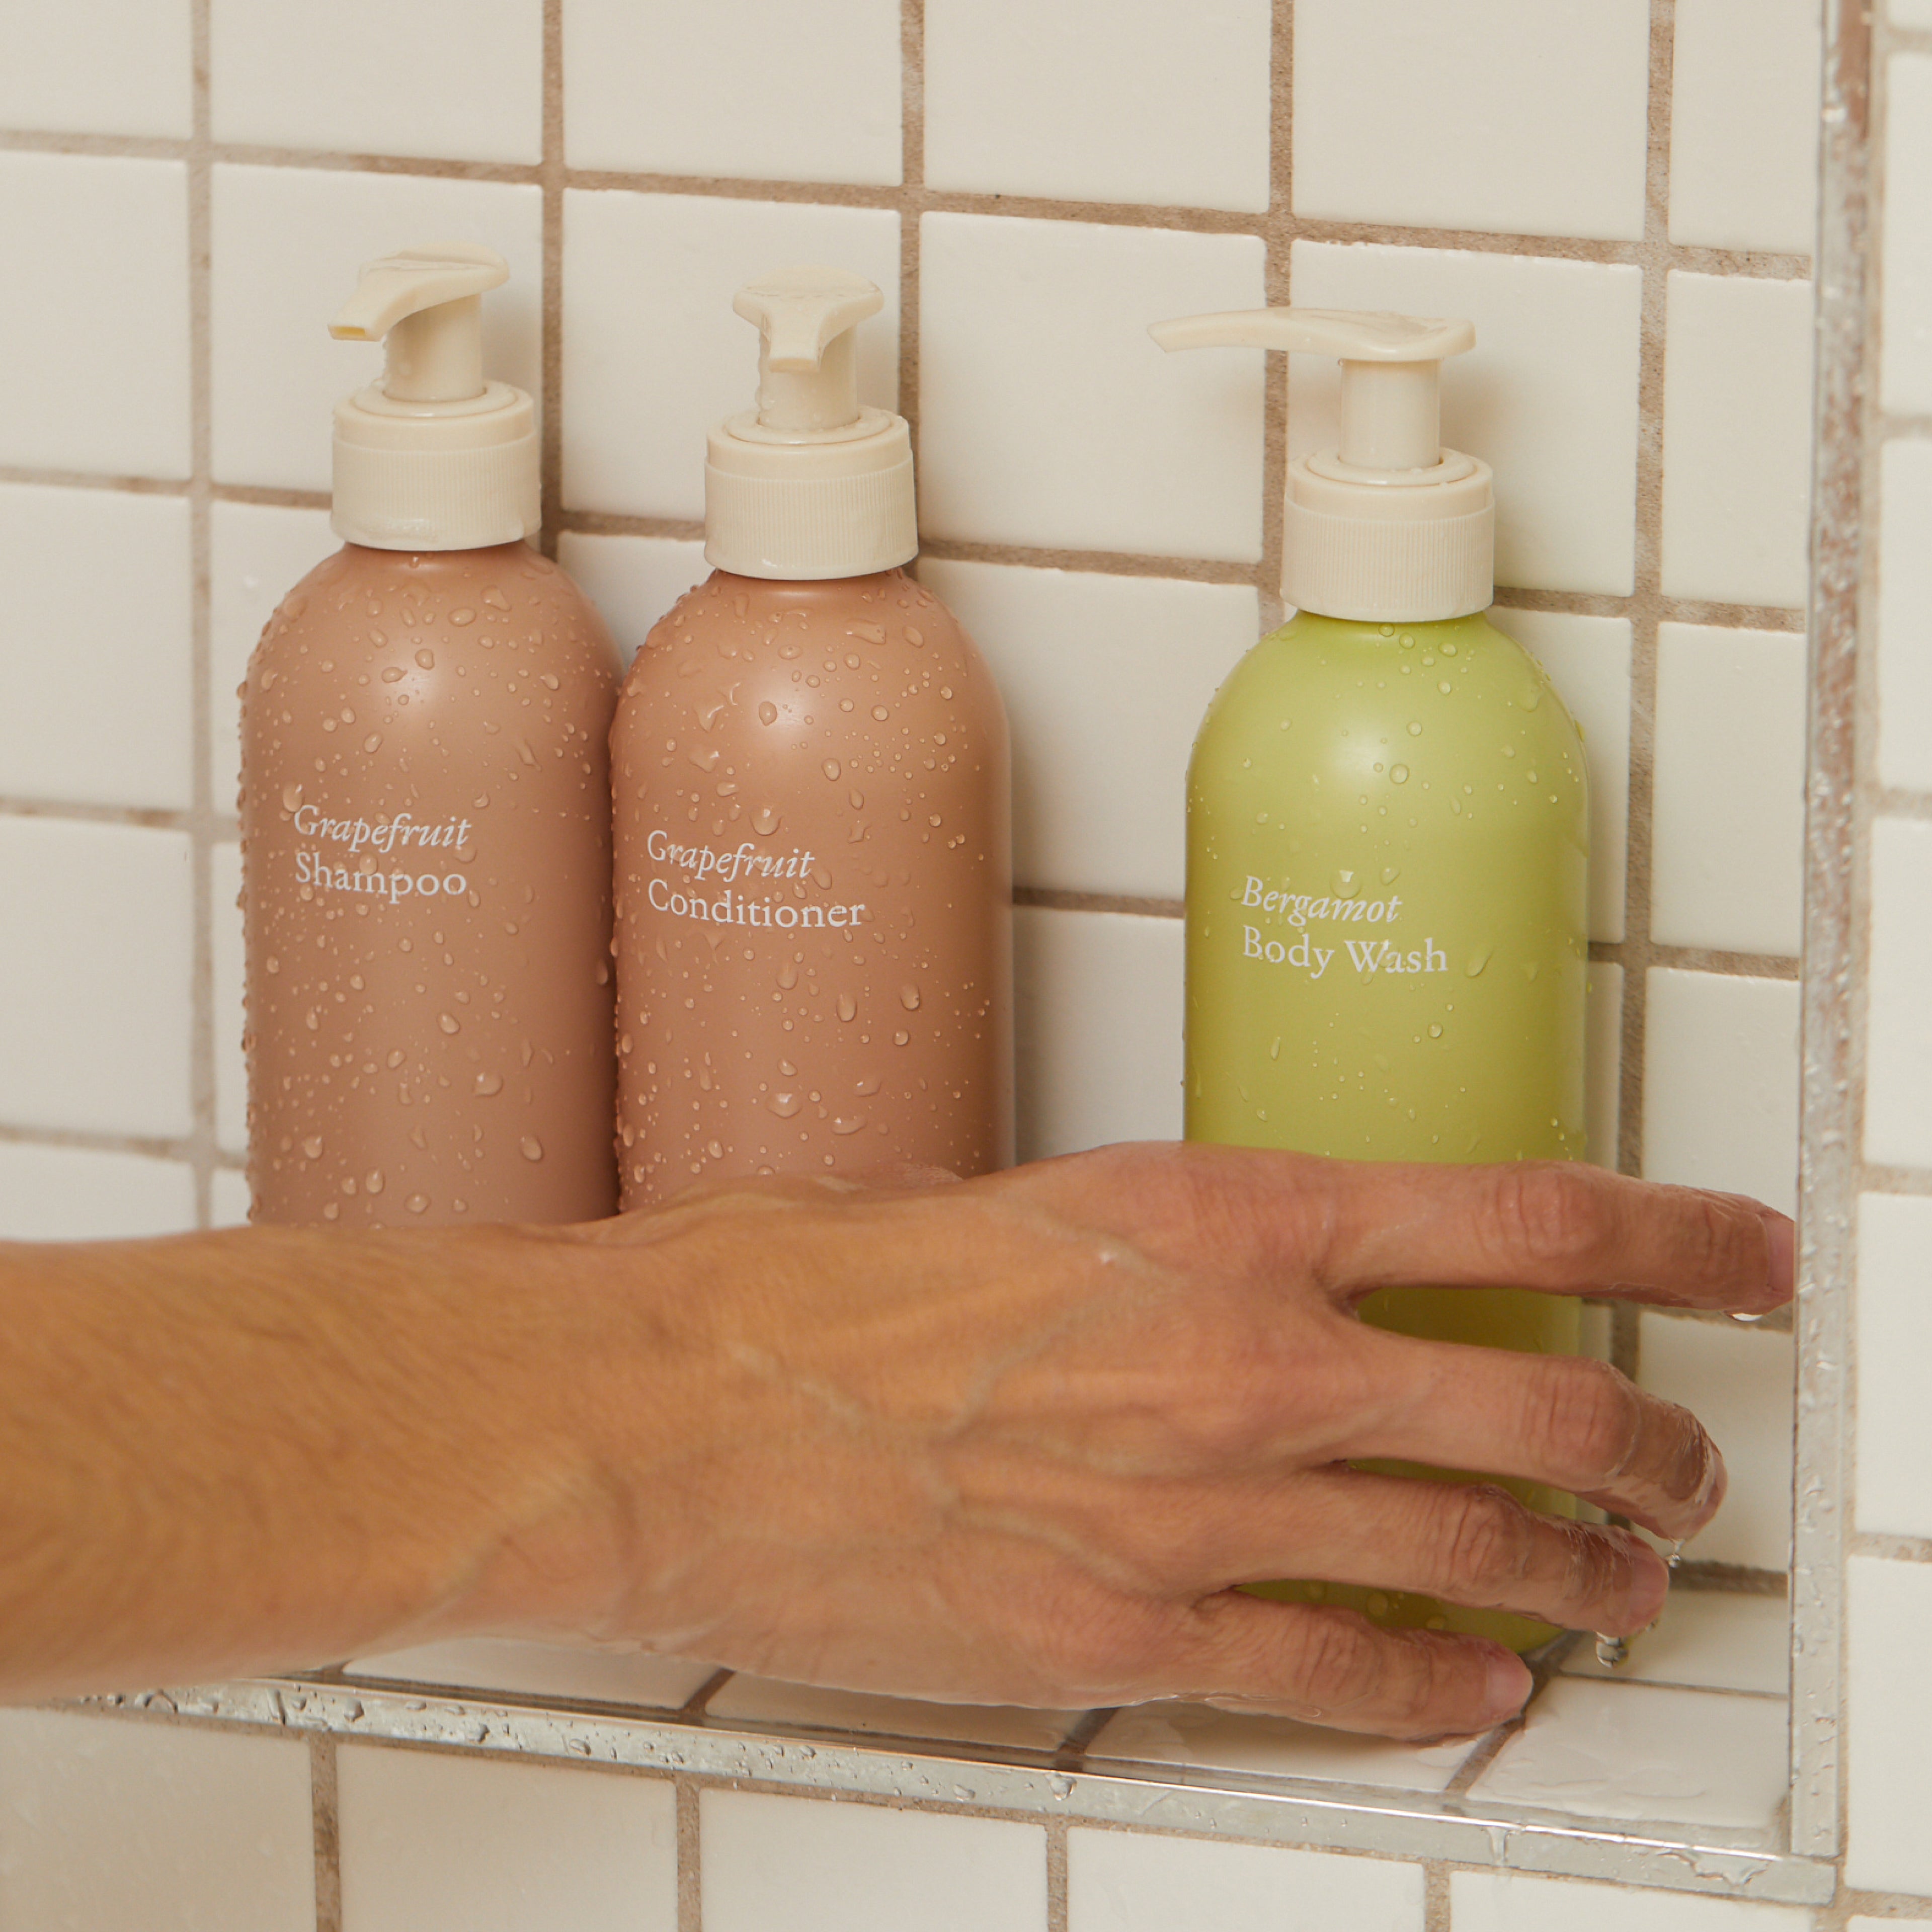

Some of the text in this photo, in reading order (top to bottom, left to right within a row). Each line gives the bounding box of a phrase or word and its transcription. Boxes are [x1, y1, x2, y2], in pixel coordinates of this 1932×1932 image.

[294, 805, 471, 853] Grapefruit
[296, 852, 466, 904] Shampoo
[647, 830, 815, 882] Grapefruit
[648, 878, 865, 927] Conditioner
[1241, 875, 1402, 926] Bergamot
[1243, 925, 1447, 979] Body Wash
